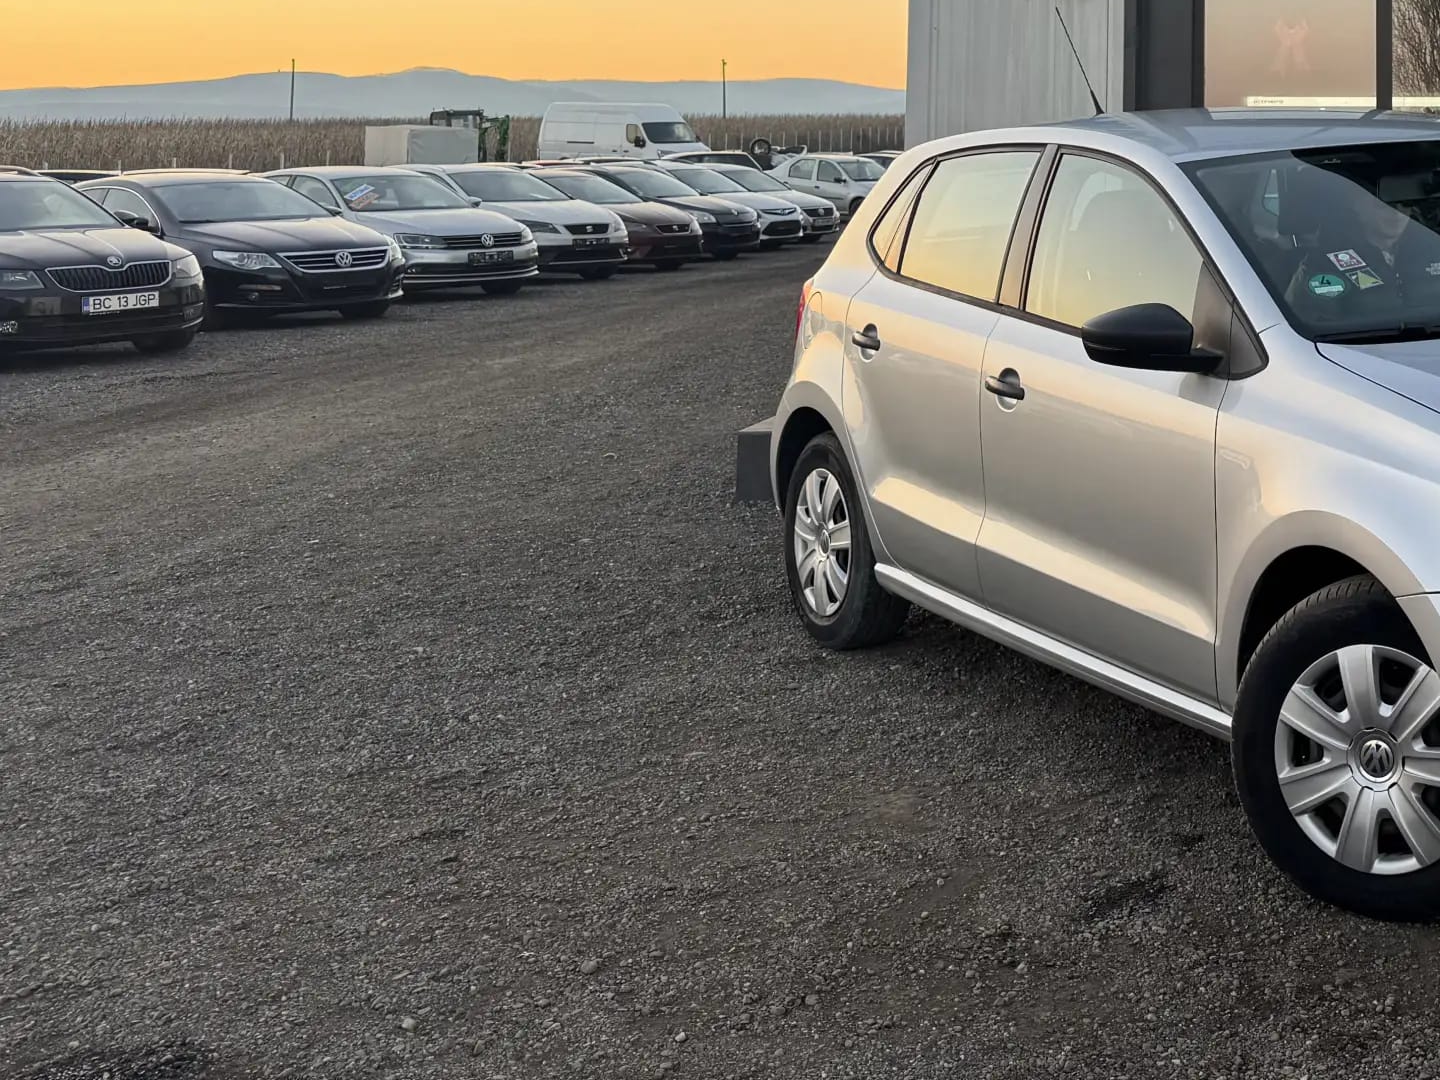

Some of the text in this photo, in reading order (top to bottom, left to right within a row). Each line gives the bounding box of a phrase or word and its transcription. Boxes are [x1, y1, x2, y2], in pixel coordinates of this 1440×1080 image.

[92, 293, 156, 310] BC 13 JGP
